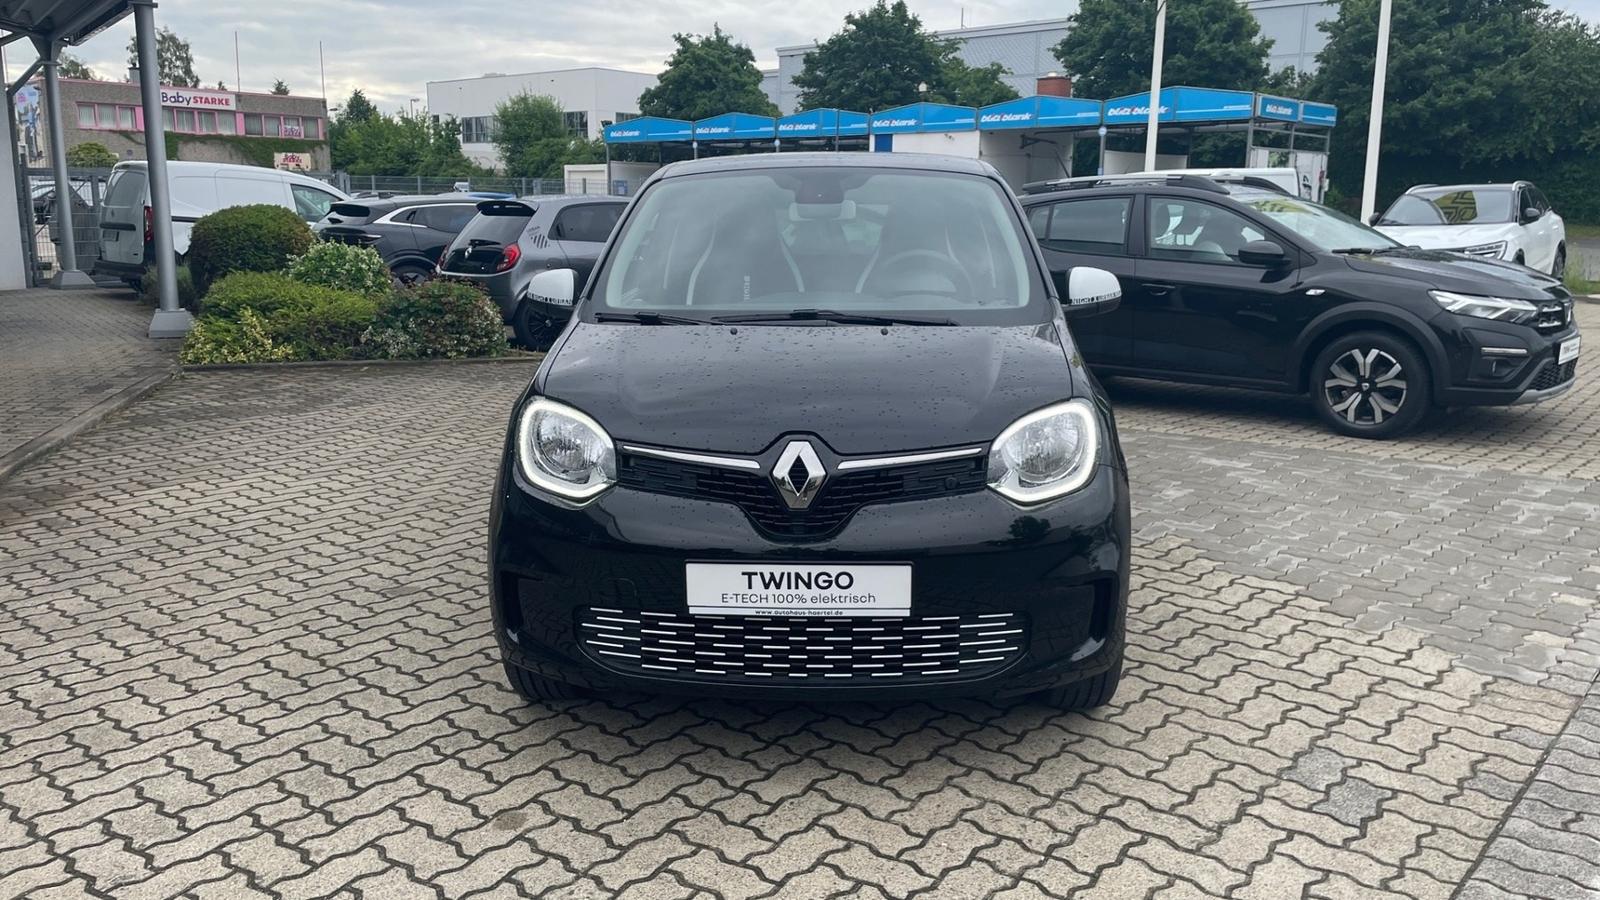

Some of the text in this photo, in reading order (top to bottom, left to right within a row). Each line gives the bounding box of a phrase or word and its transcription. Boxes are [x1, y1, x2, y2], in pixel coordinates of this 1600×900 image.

[161, 92, 231, 106] Baby STARKE
[741, 571, 854, 590] TWINGO
[721, 593, 876, 604] E-TECH 100% elektrisch
